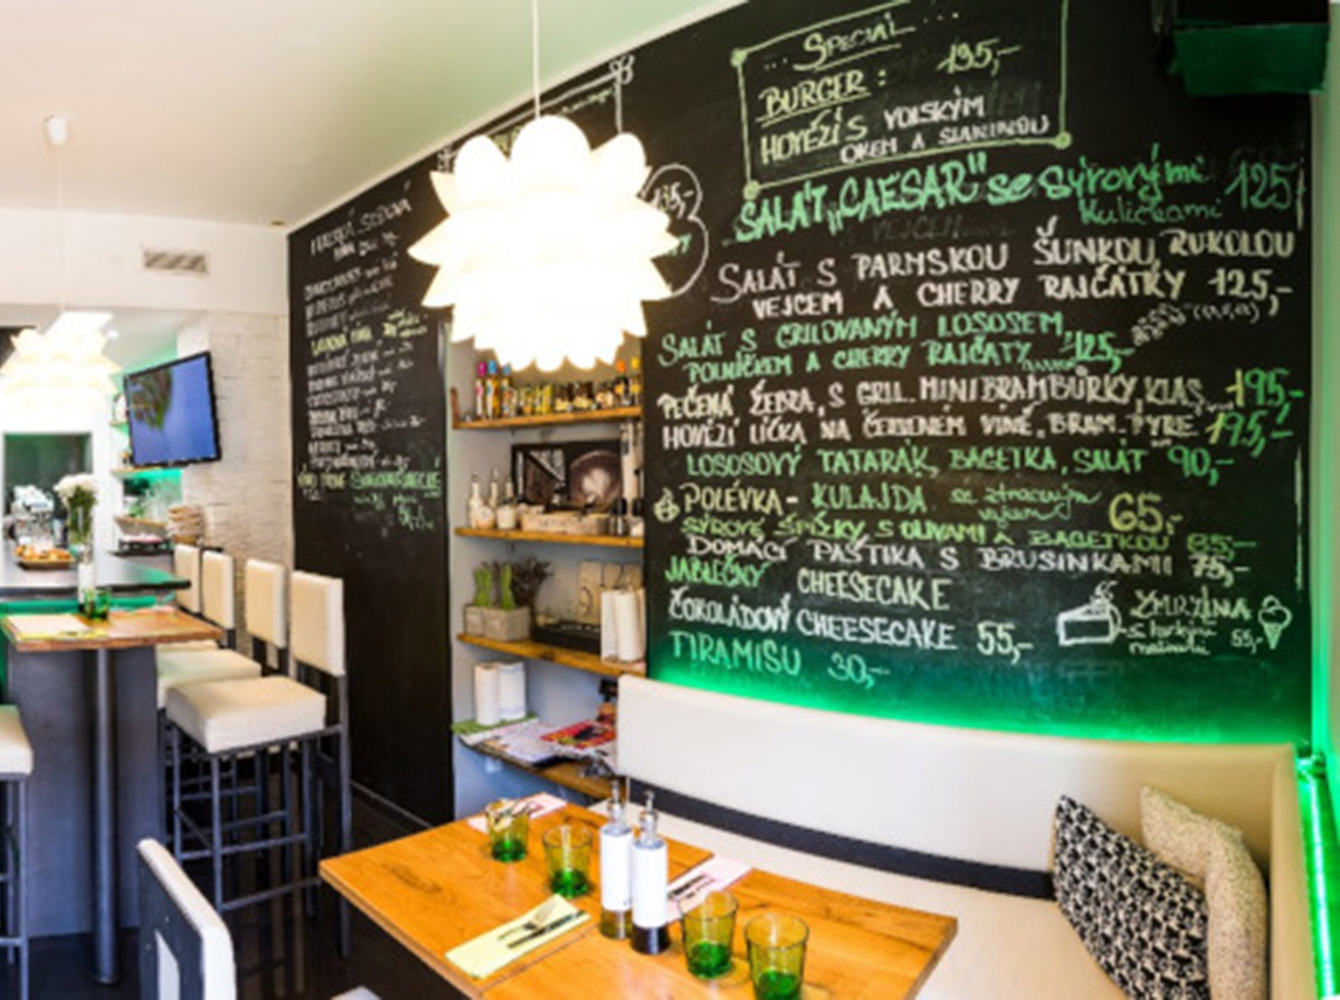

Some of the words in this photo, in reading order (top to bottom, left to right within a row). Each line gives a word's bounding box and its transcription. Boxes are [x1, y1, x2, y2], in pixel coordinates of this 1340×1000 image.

[758, 69, 871, 125] BURGER
[845, 116, 868, 141] S
[840, 137, 898, 163] OKEM
[912, 132, 925, 149] A
[817, 258, 837, 287] S
[851, 245, 1009, 281] PARMSKOU
[1160, 228, 1294, 258] RUKOLOU
[752, 291, 844, 319] VEJCEM
[872, 285, 893, 311] A
[916, 277, 1021, 308] CHERRY
[739, 329, 758, 353] S
[937, 311, 1063, 339] LOSOSEM
[805, 351, 820, 373] A
[833, 345, 911, 370] CHERRY
[829, 383, 844, 408] S
[820, 418, 852, 442] NA
[810, 482, 928, 514] KULAJDA
[874, 520, 894, 538] S
[993, 531, 1014, 545] A
[939, 547, 961, 570] S
[796, 567, 953, 611] CHEESECAKE
[796, 608, 958, 652] CHEESECAKE
[669, 630, 802, 677] TIRAMISU
